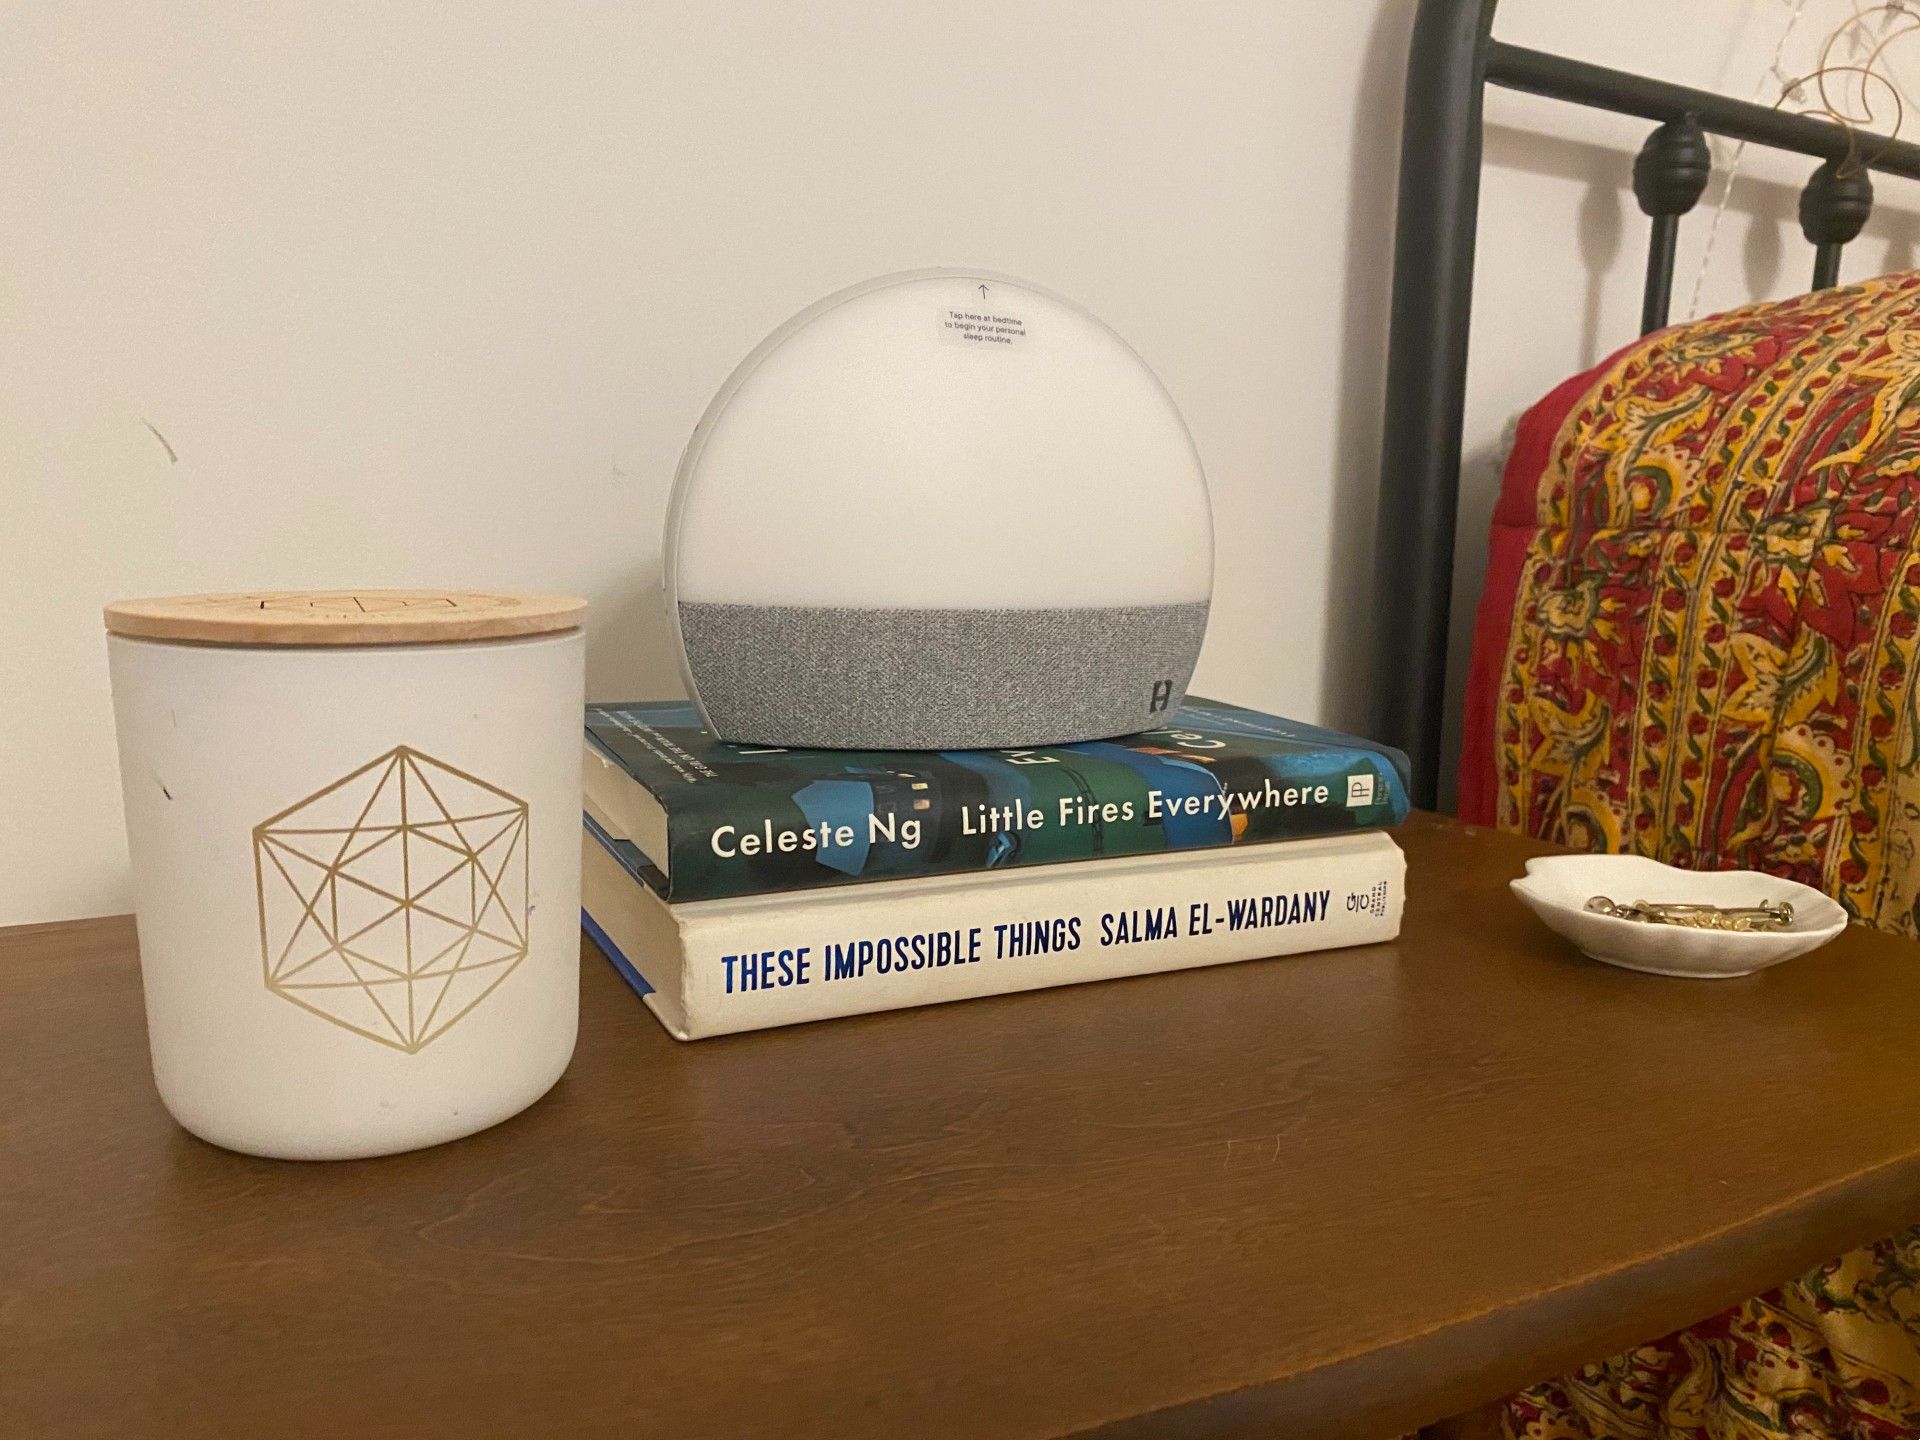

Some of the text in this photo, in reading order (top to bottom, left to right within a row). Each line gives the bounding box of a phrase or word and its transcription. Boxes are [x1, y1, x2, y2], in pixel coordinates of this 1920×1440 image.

[949, 311, 1022, 326] Tap here at bedtime
[954, 322, 976, 331] begin
[995, 326, 1026, 336] personal
[963, 333, 1013, 345] sleep routine.
[711, 779, 1329, 858] Celeste Ng Little Fires Everywhere
[721, 890, 1330, 994] THESE IMPOSSIBLE THINGS SALMA EL-WARDANY
